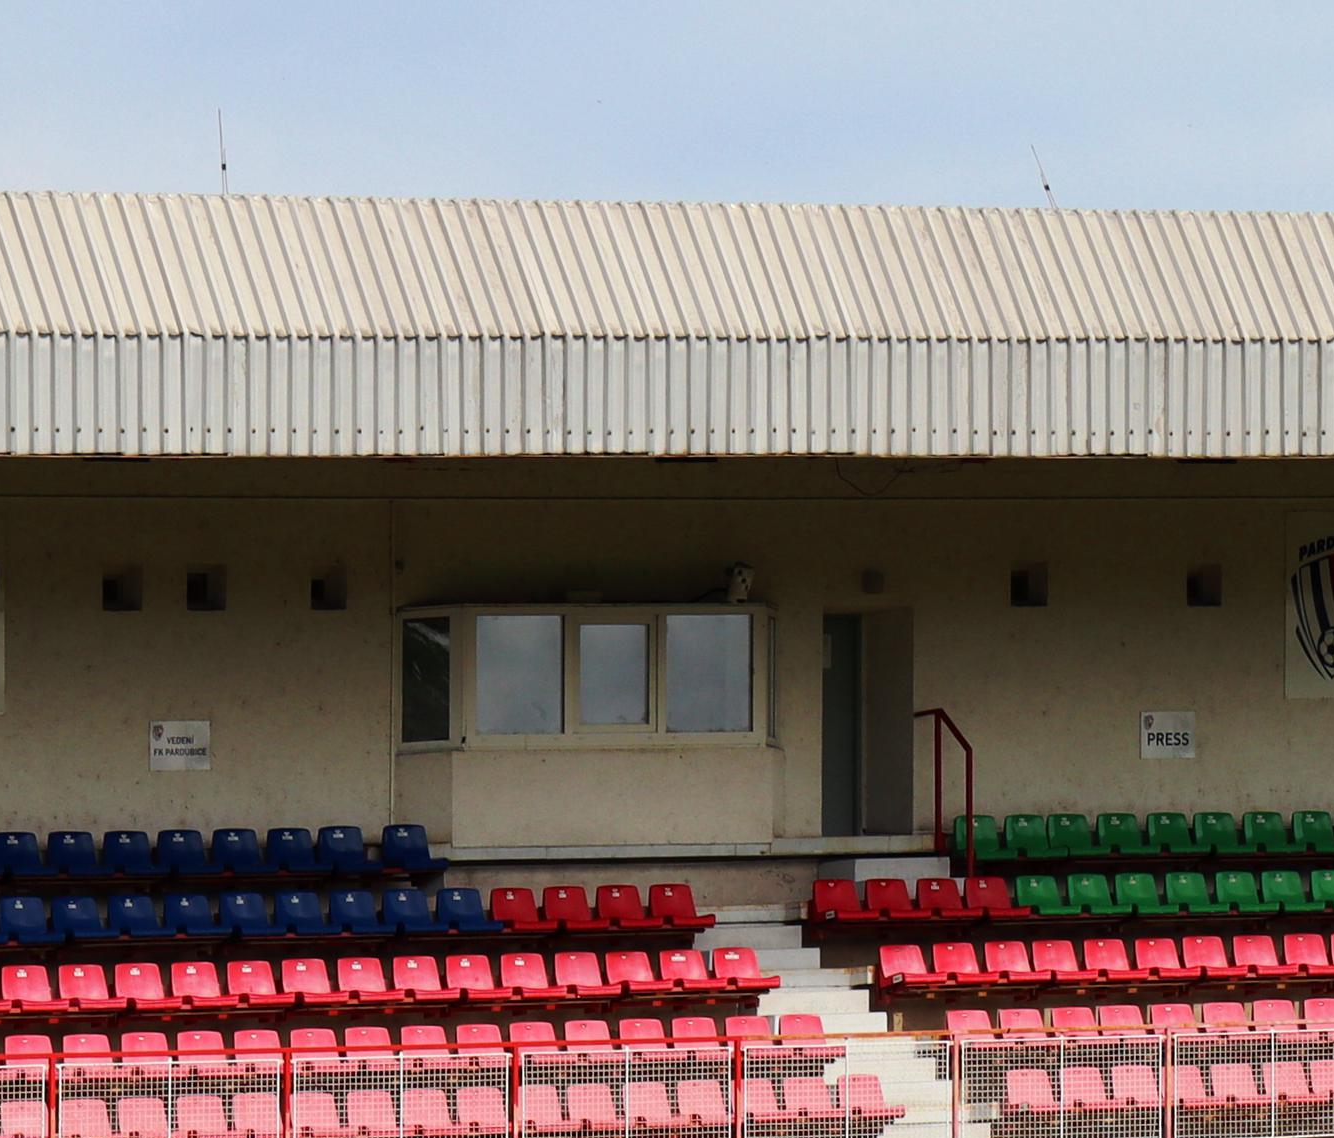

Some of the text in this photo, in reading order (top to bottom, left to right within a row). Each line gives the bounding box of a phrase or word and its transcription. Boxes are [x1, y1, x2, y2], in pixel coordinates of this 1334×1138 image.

[1147, 732, 1189, 746] PRESS
[154, 748, 207, 756] FK PARDUBICE
